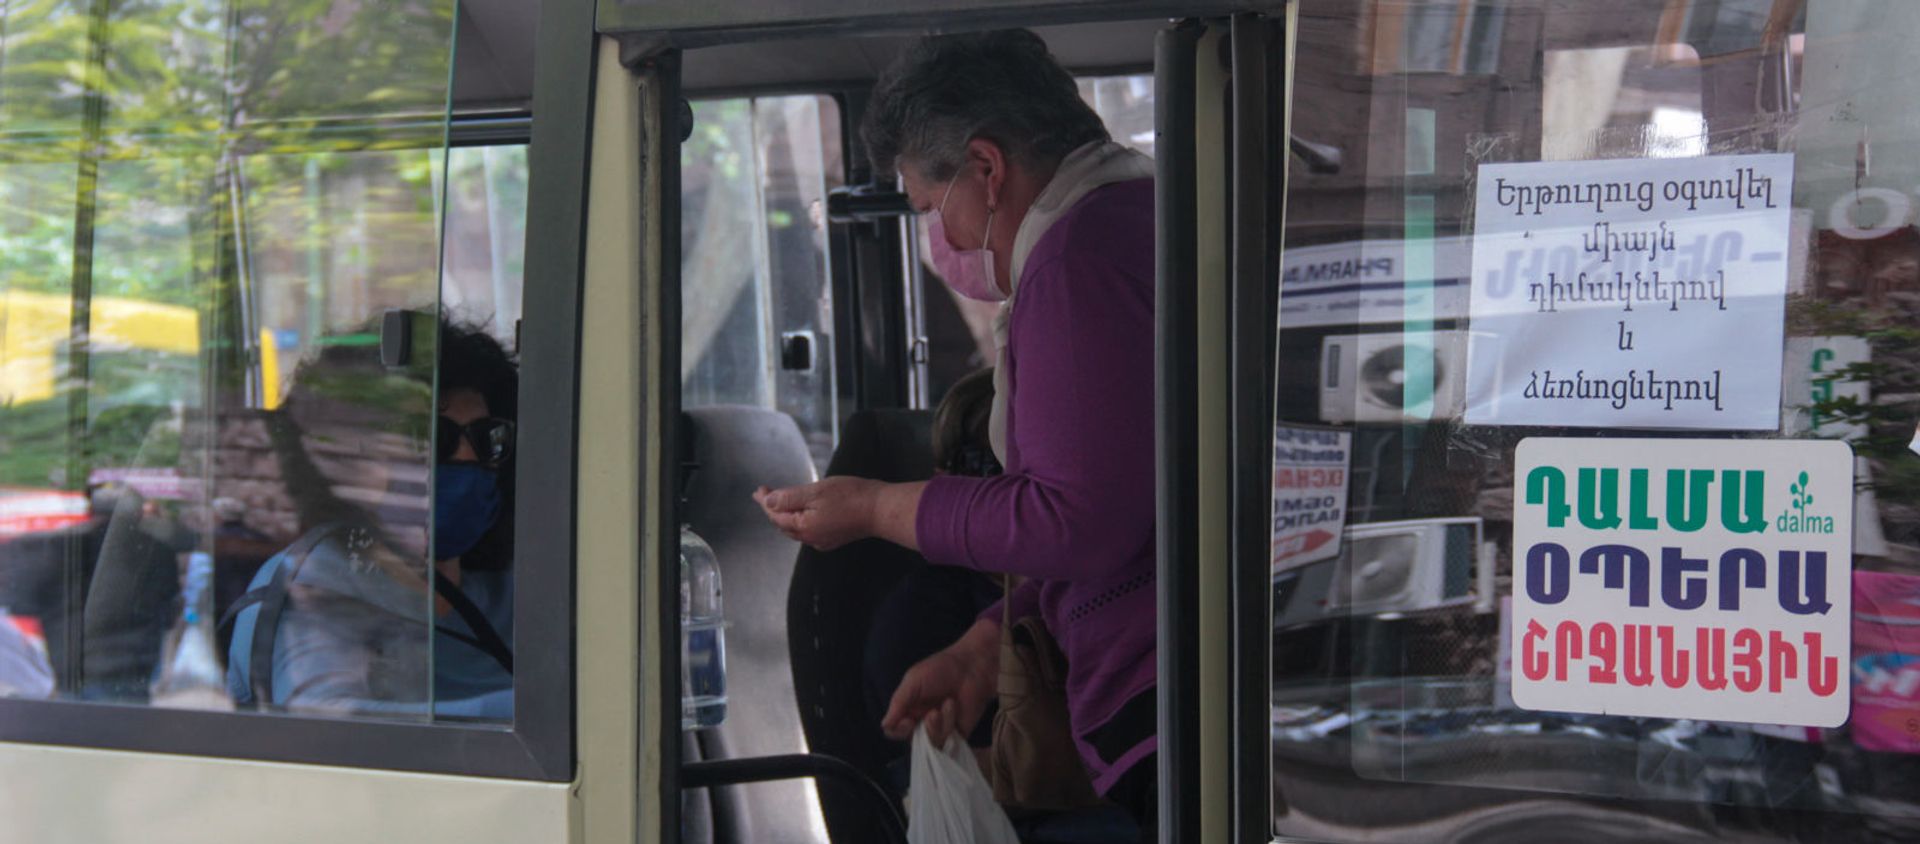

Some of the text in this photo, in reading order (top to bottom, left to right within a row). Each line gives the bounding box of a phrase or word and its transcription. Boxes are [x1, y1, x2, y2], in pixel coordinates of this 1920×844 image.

[1496, 168, 1777, 216] Երթուղուց օգտվել
[1583, 221, 1676, 263] միայն
[1529, 271, 1728, 313] դիմակներով
[1618, 321, 1635, 351] և
[1524, 370, 1723, 412] ձեռնոցներով
[1525, 465, 1769, 534] ԴԱԼՄԱ
[1777, 508, 1834, 534] dalma
[1525, 541, 1833, 616] ՕՊԵՐԱ
[1521, 618, 1839, 698] ՇՐՋԱՆԱՅԻՆ
